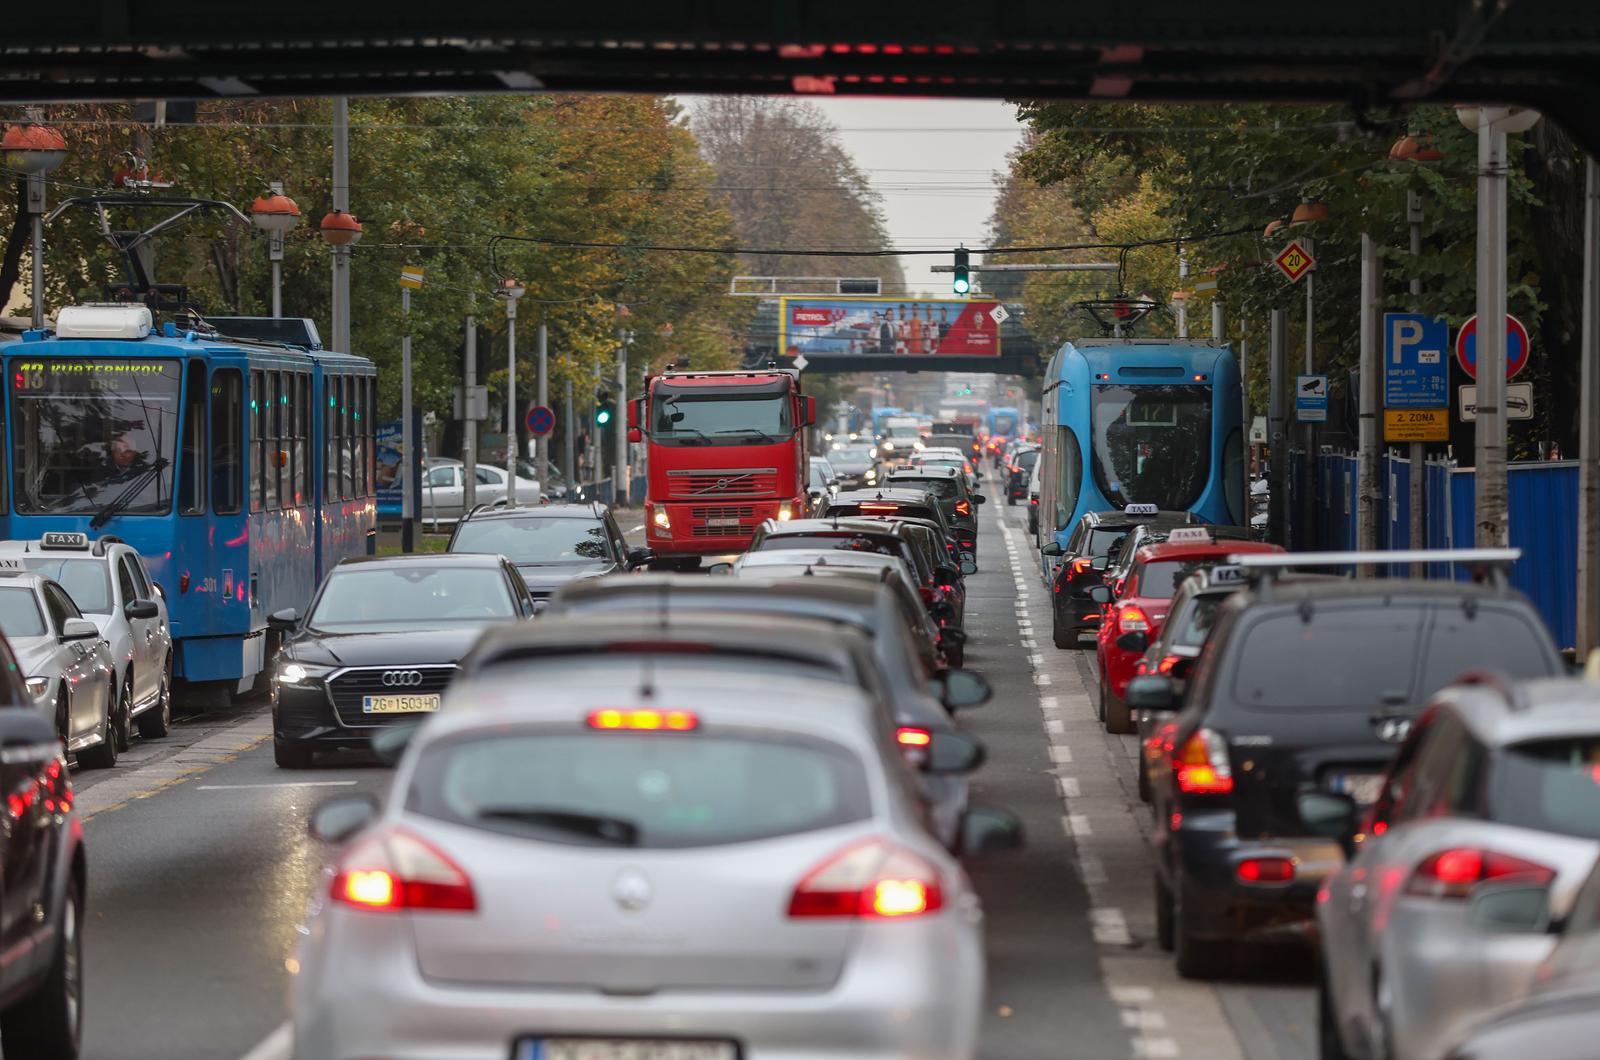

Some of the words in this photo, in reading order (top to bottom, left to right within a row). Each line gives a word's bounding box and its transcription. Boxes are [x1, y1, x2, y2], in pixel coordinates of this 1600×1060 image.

[1288, 255, 1300, 266] 20
[796, 312, 826, 322] PETROL
[996, 311, 1002, 319] S
[1393, 320, 1423, 363] P
[1409, 414, 1435, 422] ZONA
[50, 534, 81, 544] TAXI
[1175, 531, 1202, 539] TAXI
[373, 698, 387, 711] ZG
